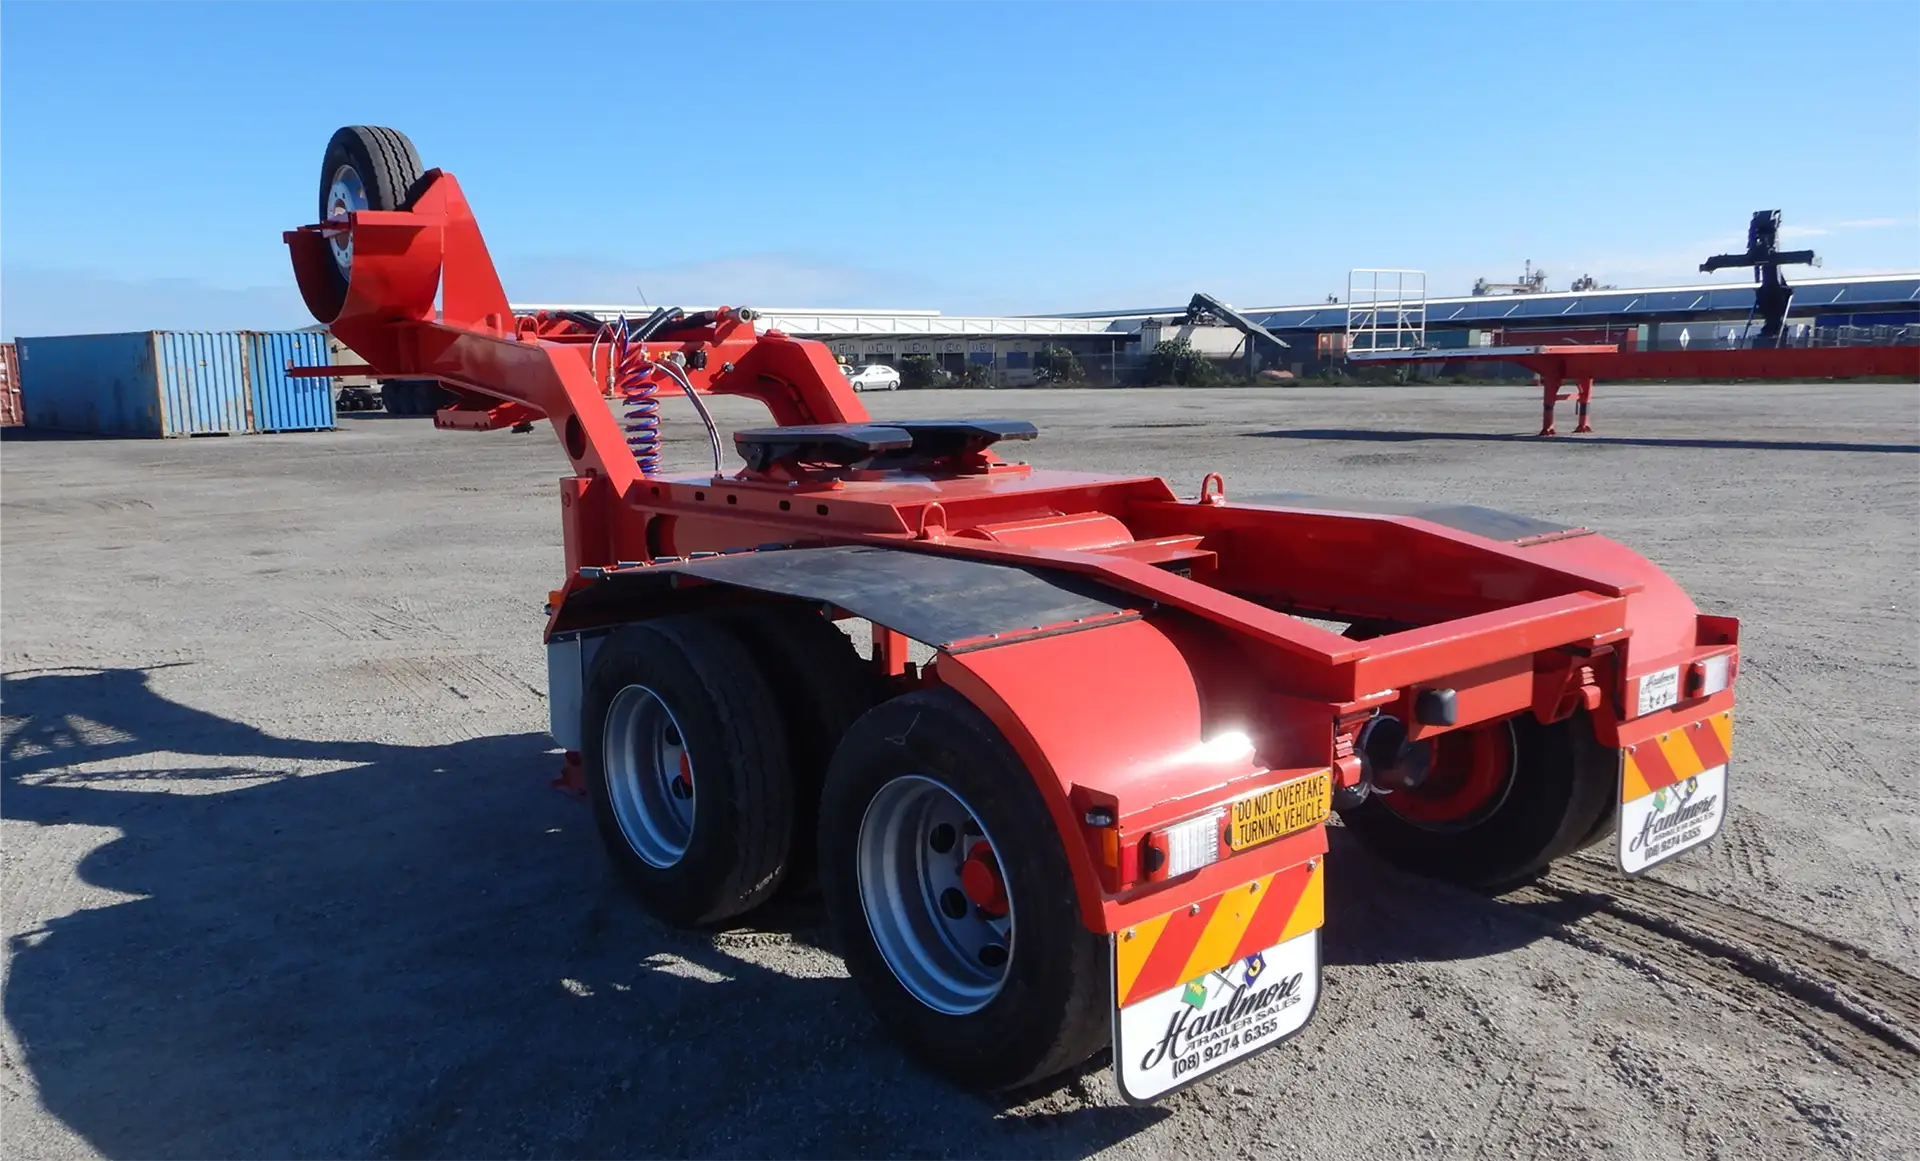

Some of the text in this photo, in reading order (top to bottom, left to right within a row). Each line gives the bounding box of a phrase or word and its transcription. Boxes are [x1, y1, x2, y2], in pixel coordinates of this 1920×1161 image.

[1238, 776, 1324, 822] DO NOT OVERTAKE
[1240, 799, 1323, 845] TURNING VEHICLE
[1629, 794, 1717, 853] Haulmore
[1139, 972, 1303, 1071] Haulmore
[1172, 1017, 1279, 1080] (08) 9274 6355
[1188, 994, 1301, 1050] TRAILER SALES
